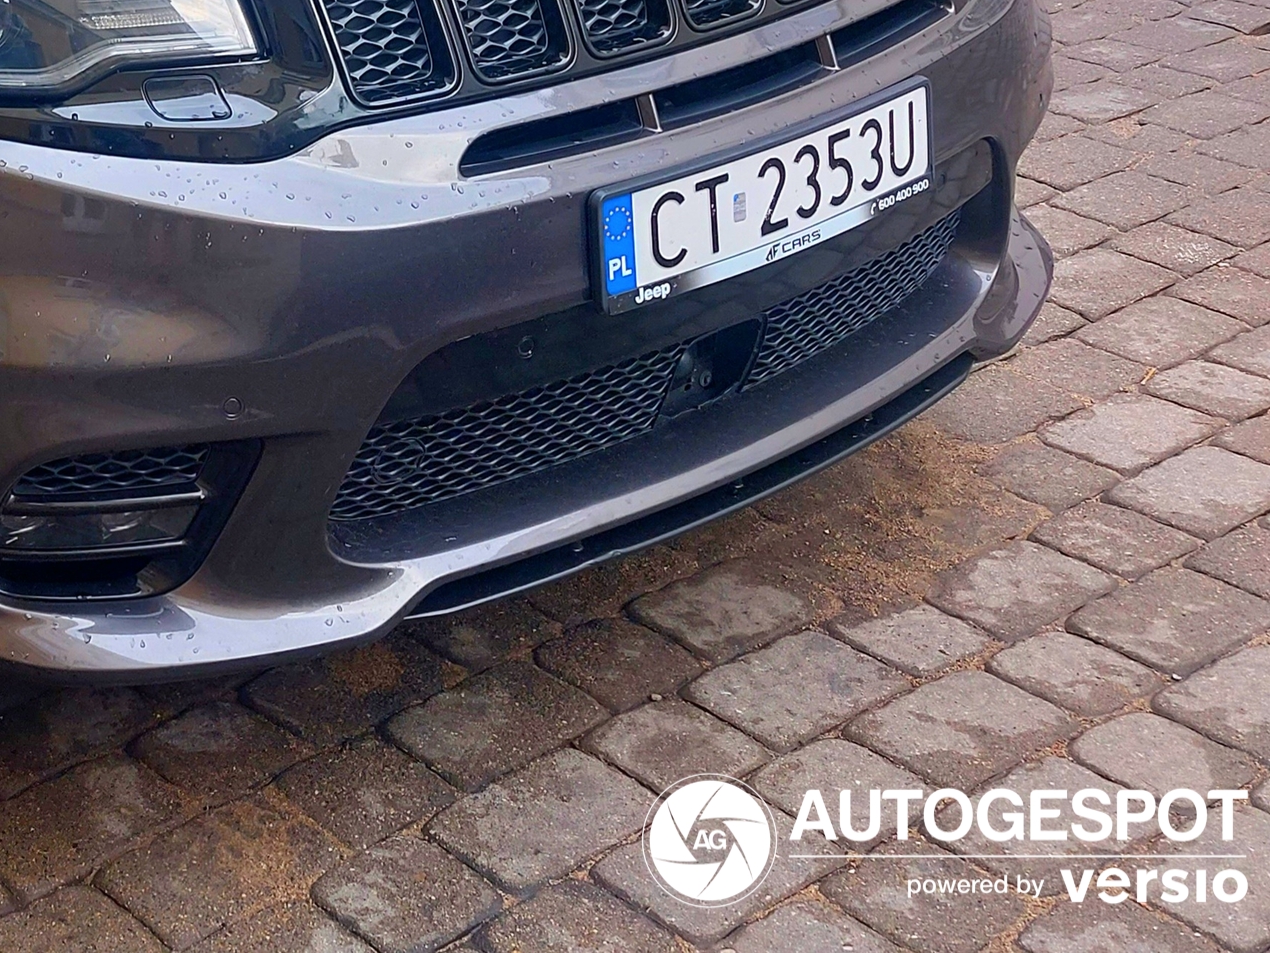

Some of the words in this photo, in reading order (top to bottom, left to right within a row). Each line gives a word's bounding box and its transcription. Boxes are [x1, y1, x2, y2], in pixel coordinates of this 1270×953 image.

[651, 173, 729, 268] CT
[758, 101, 914, 237] 2353U
[878, 195, 895, 211] 600
[896, 187, 912, 202] 400
[912, 179, 929, 195] 900
[782, 229, 821, 253] CARS
[608, 255, 632, 281] PL
[634, 282, 671, 304] Jeep
